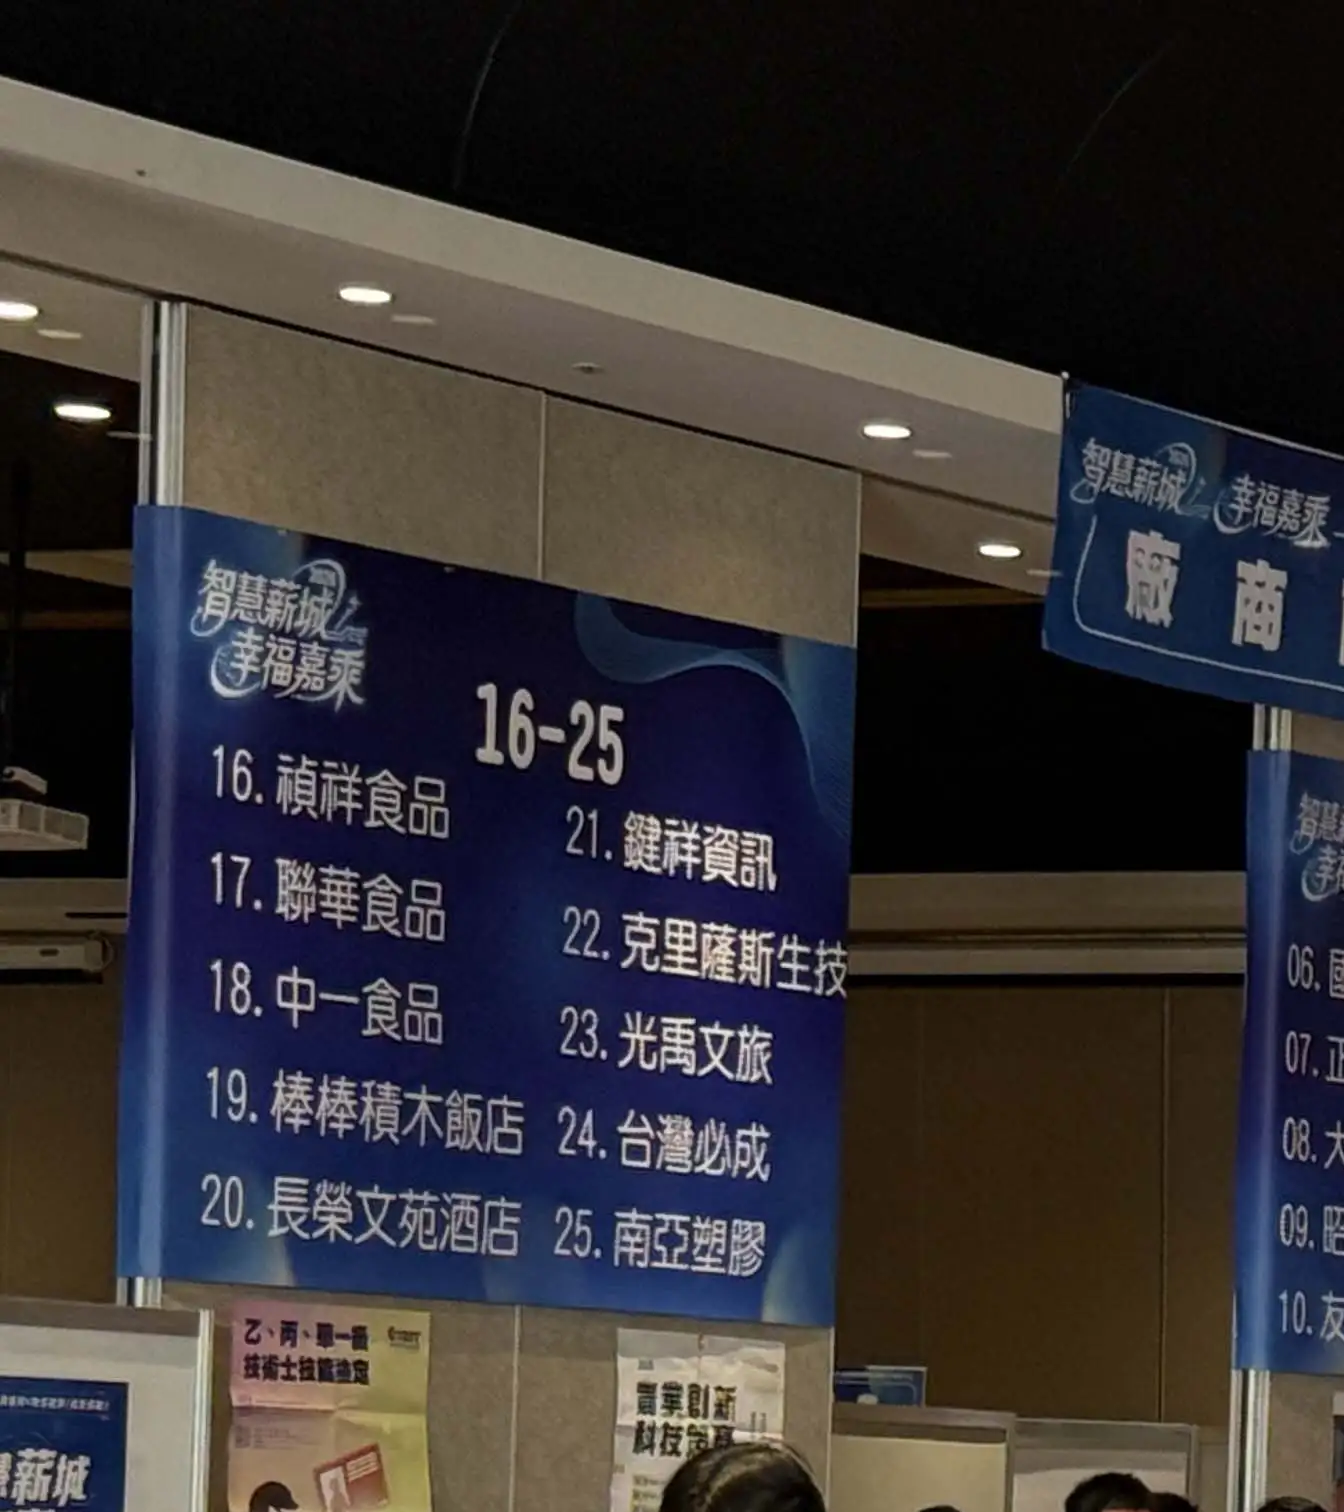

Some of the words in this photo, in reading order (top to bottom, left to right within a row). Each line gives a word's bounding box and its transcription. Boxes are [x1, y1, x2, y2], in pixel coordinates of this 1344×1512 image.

[202, 560, 334, 638] 智慧薪城
[475, 682, 625, 785] 16-25
[276, 755, 449, 839] 禎祥食品
[624, 811, 777, 891] 鍵祥資訊
[275, 859, 445, 943] 聯華食品
[620, 912, 848, 998] 克里薩斯生技
[276, 967, 443, 1044] 中一食品
[618, 1010, 773, 1085] 光禹文旅
[271, 1070, 524, 1156] 棒棒積木飯店
[617, 1110, 771, 1182] 台灣必成
[267, 1177, 520, 1258] 長榮文苑酒店
[613, 1208, 766, 1278] 南亞塑膠
